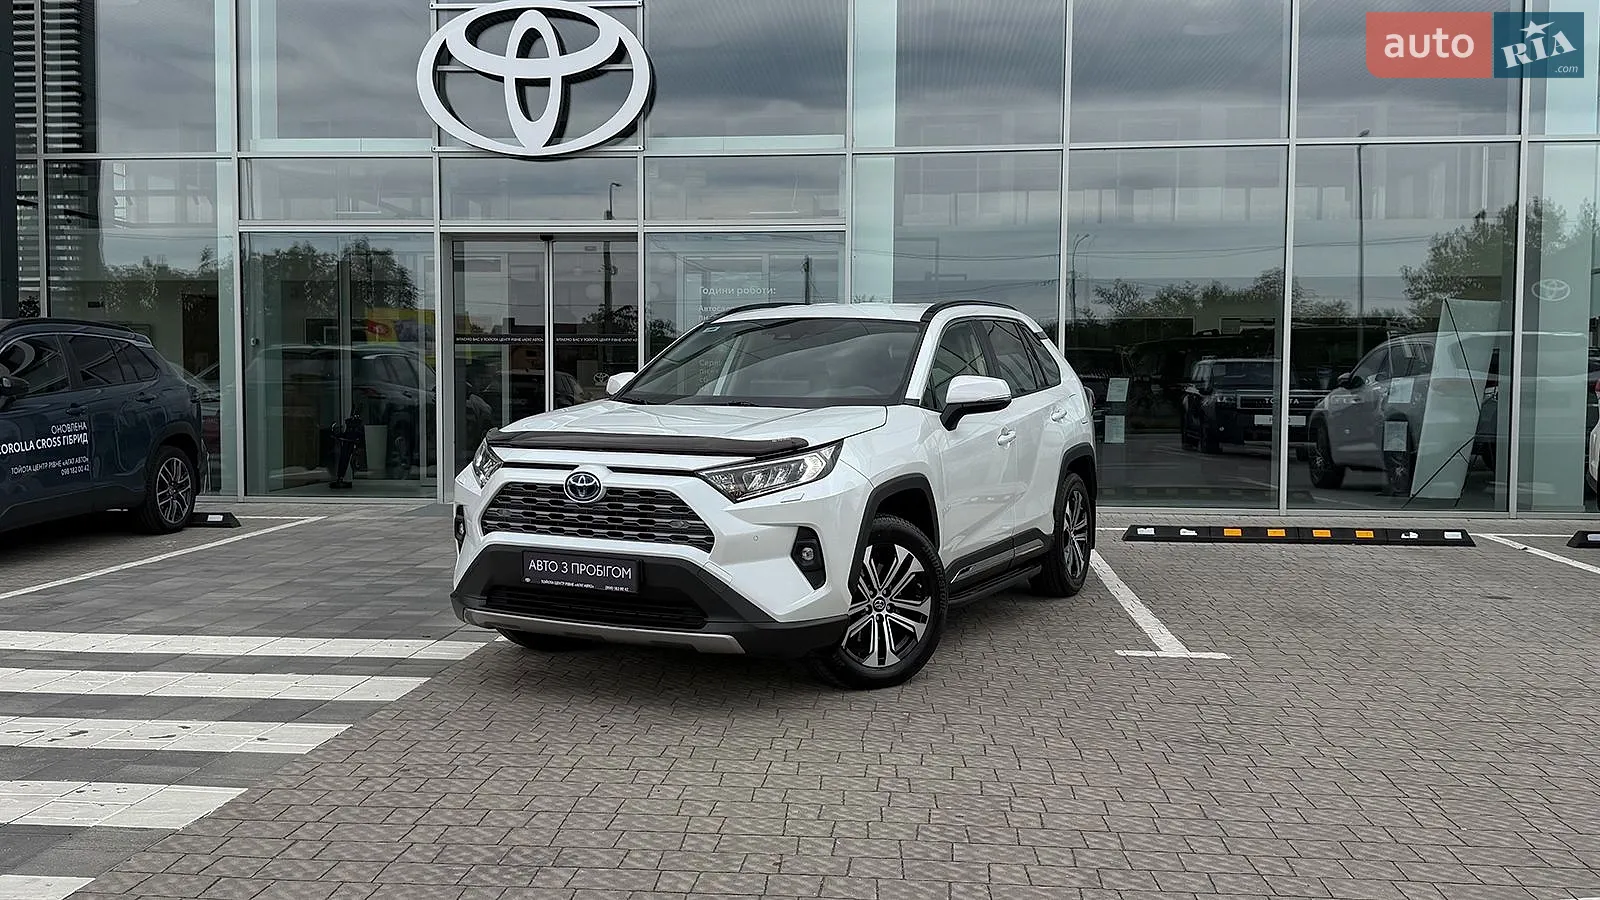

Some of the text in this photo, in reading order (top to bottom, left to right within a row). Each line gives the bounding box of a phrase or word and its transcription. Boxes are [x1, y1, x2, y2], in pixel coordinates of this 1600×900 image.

[700, 286, 776, 296] Години роботи:
[51, 422, 87, 434] ОНОВЛЕНА
[36, 436, 61, 449] CROSS
[62, 433, 88, 445] ГІБРИД
[11, 465, 32, 475] ТОЙОТА
[32, 462, 48, 472] ЦЕНТР
[528, 560, 632, 579] АВТО З ПРОБІГОМ
